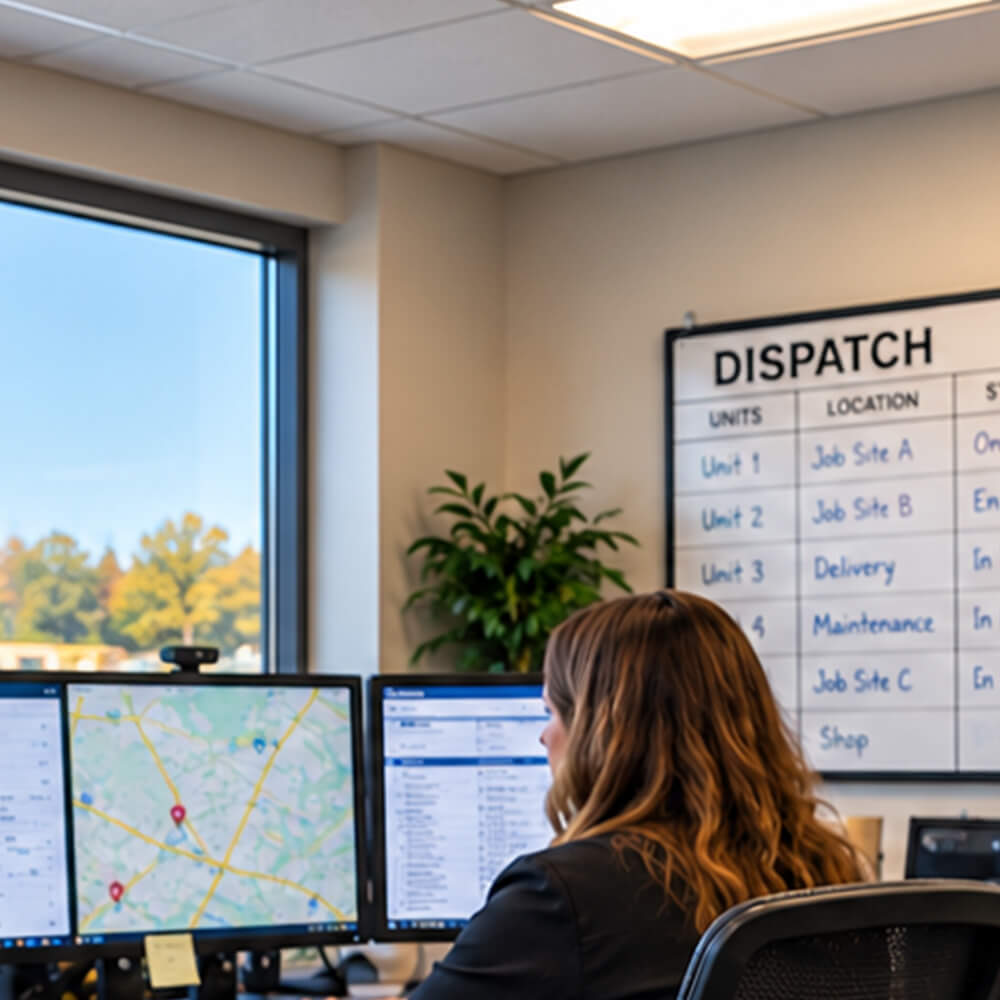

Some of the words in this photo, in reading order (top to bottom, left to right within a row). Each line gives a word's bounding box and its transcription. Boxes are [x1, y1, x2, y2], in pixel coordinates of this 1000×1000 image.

[714, 327, 932, 387] DISPATCH
[827, 392, 920, 416] LOCATION
[986, 382, 1000, 401] S
[709, 407, 763, 428] UNITS
[701, 453, 742, 478] Unit
[752, 452, 761, 474] 1
[811, 444, 846, 470] Job
[852, 441, 888, 466] Site
[898, 438, 913, 461] A
[701, 507, 742, 531] Unit
[751, 505, 764, 528] 2
[812, 499, 846, 524] Job
[853, 496, 889, 520] Site
[898, 493, 913, 518] B
[702, 562, 743, 586] Unit
[752, 560, 764, 583] 3
[814, 555, 895, 586] Delivery
[813, 612, 934, 636] Maintenance
[813, 669, 847, 694] Job
[854, 668, 891, 692] Site
[898, 667, 912, 692] C
[820, 724, 869, 758] Shop
